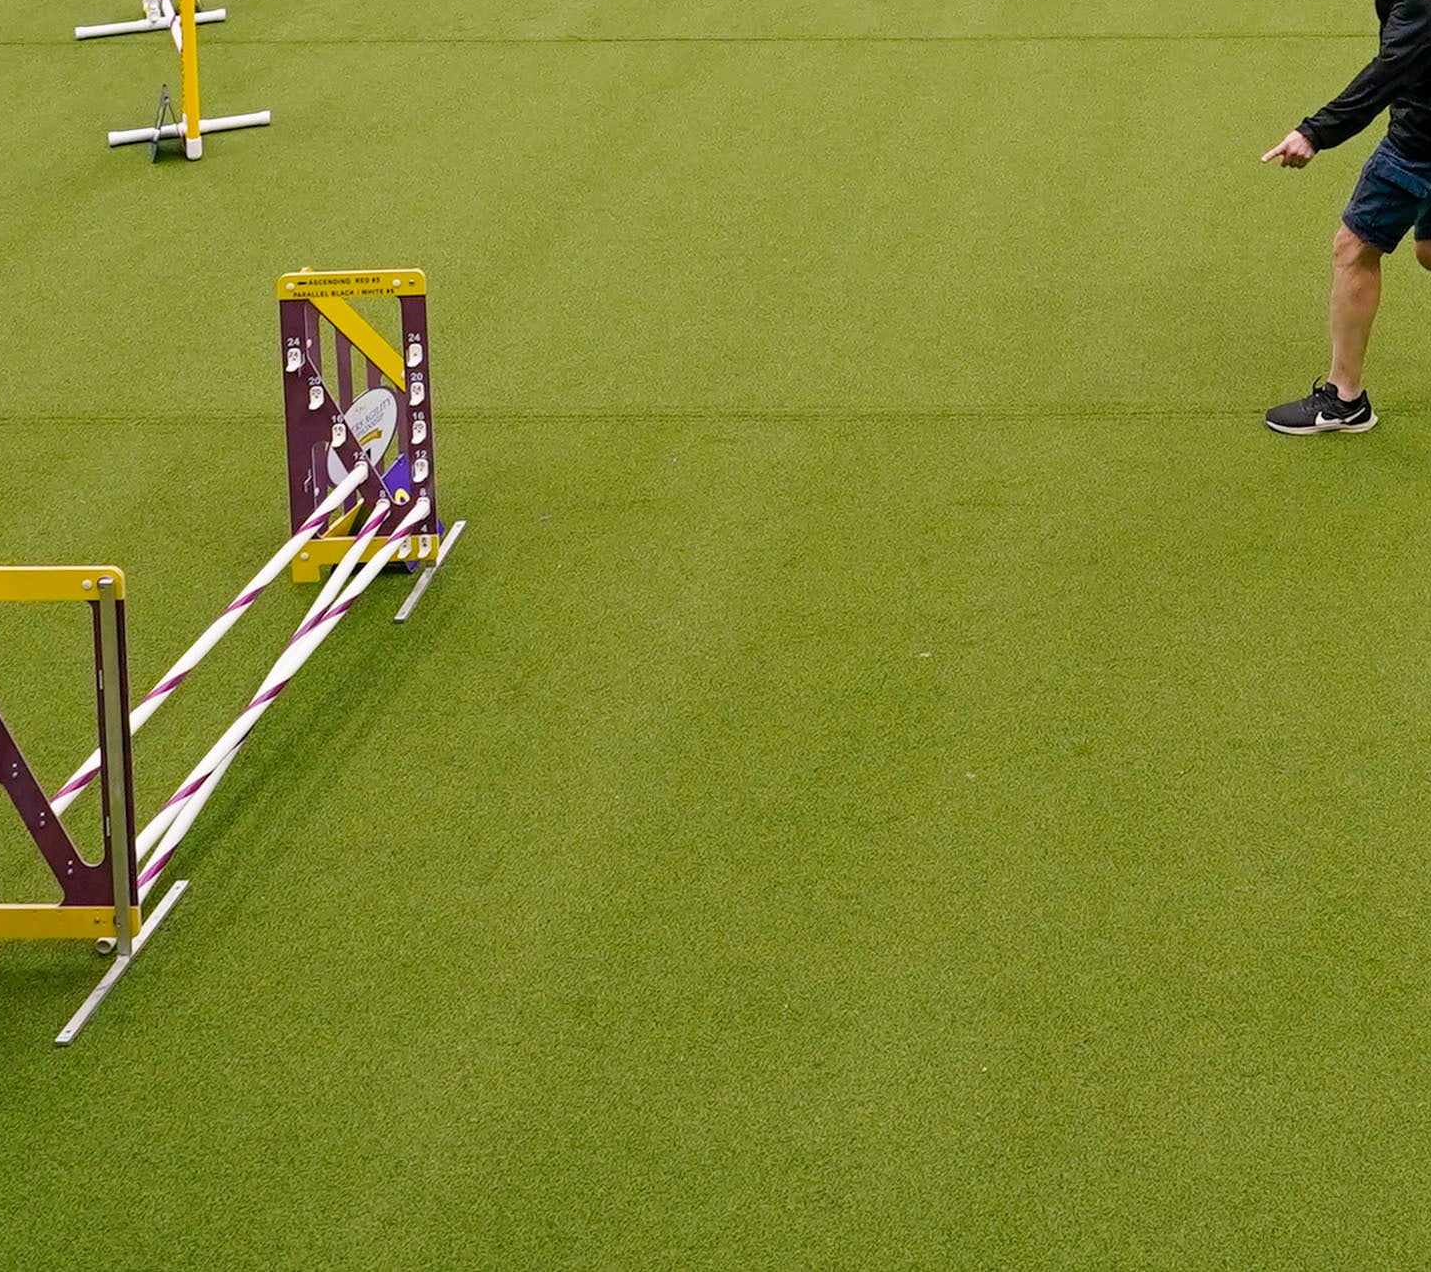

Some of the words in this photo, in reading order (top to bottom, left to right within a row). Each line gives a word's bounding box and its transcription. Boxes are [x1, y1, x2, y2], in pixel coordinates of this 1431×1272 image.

[309, 278, 351, 286] ASCENDING
[287, 338, 300, 346] 24
[407, 333, 421, 342] 24
[308, 376, 320, 385] 20
[410, 372, 423, 382] 20
[353, 451, 366, 460] 12
[414, 450, 427, 459] 12
[420, 524, 428, 533] 4
